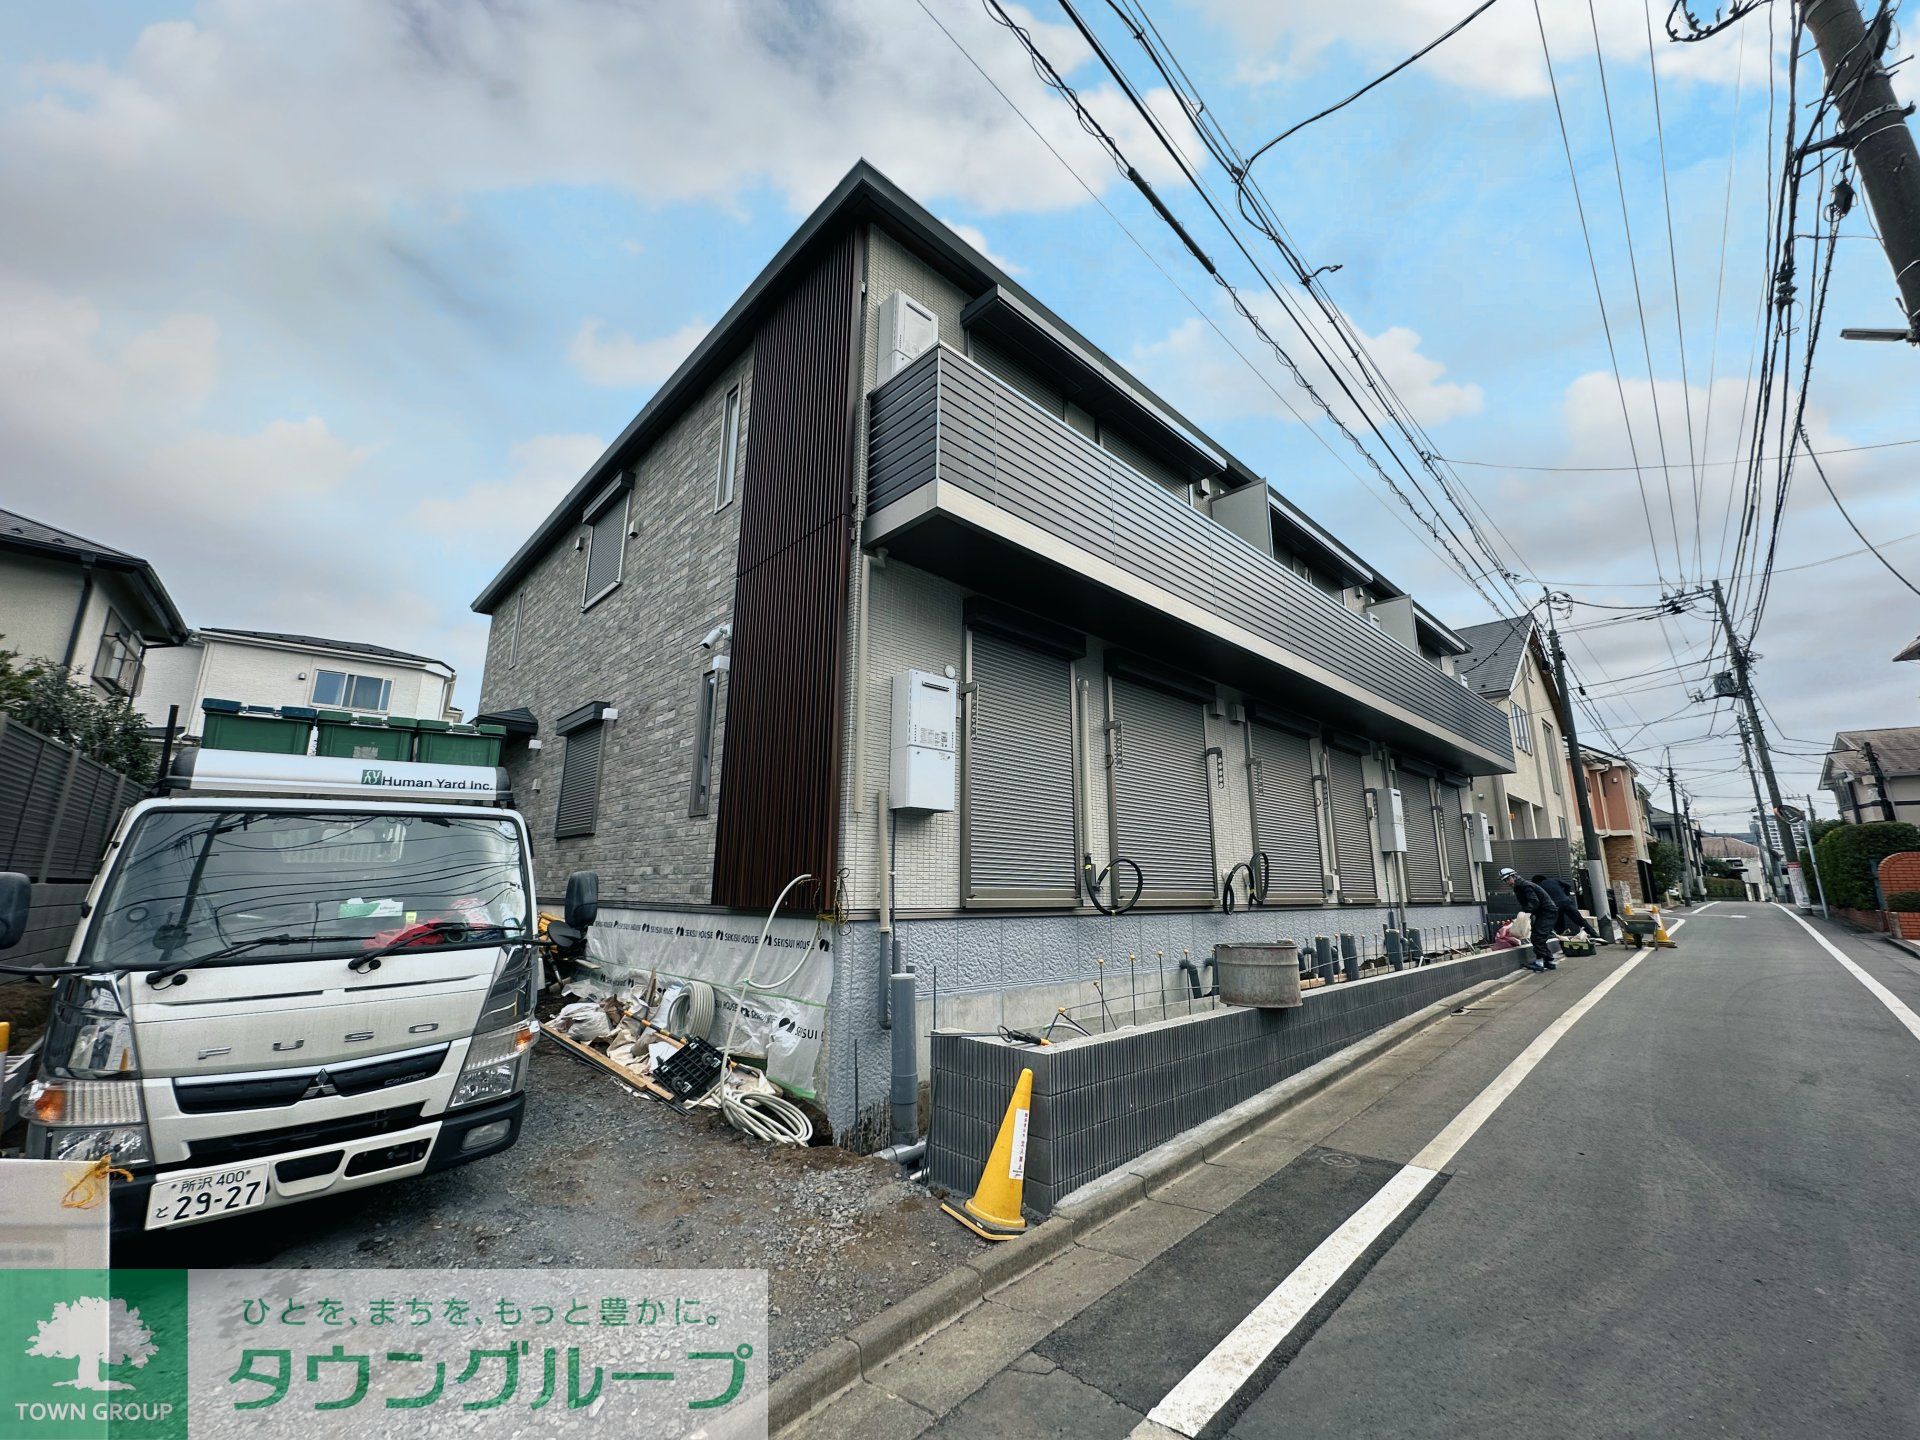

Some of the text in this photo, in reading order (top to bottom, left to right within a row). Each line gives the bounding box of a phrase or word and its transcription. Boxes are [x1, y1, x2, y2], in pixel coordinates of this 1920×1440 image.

[382, 776, 493, 791] Human Yard Inc.
[741, 934, 759, 944] HOUSE
[773, 937, 795, 949] SEKISUI
[198, 1022, 439, 1060] FUSO
[180, 1170, 245, 1193] 所沢 400
[156, 1181, 261, 1220] と 29-27
